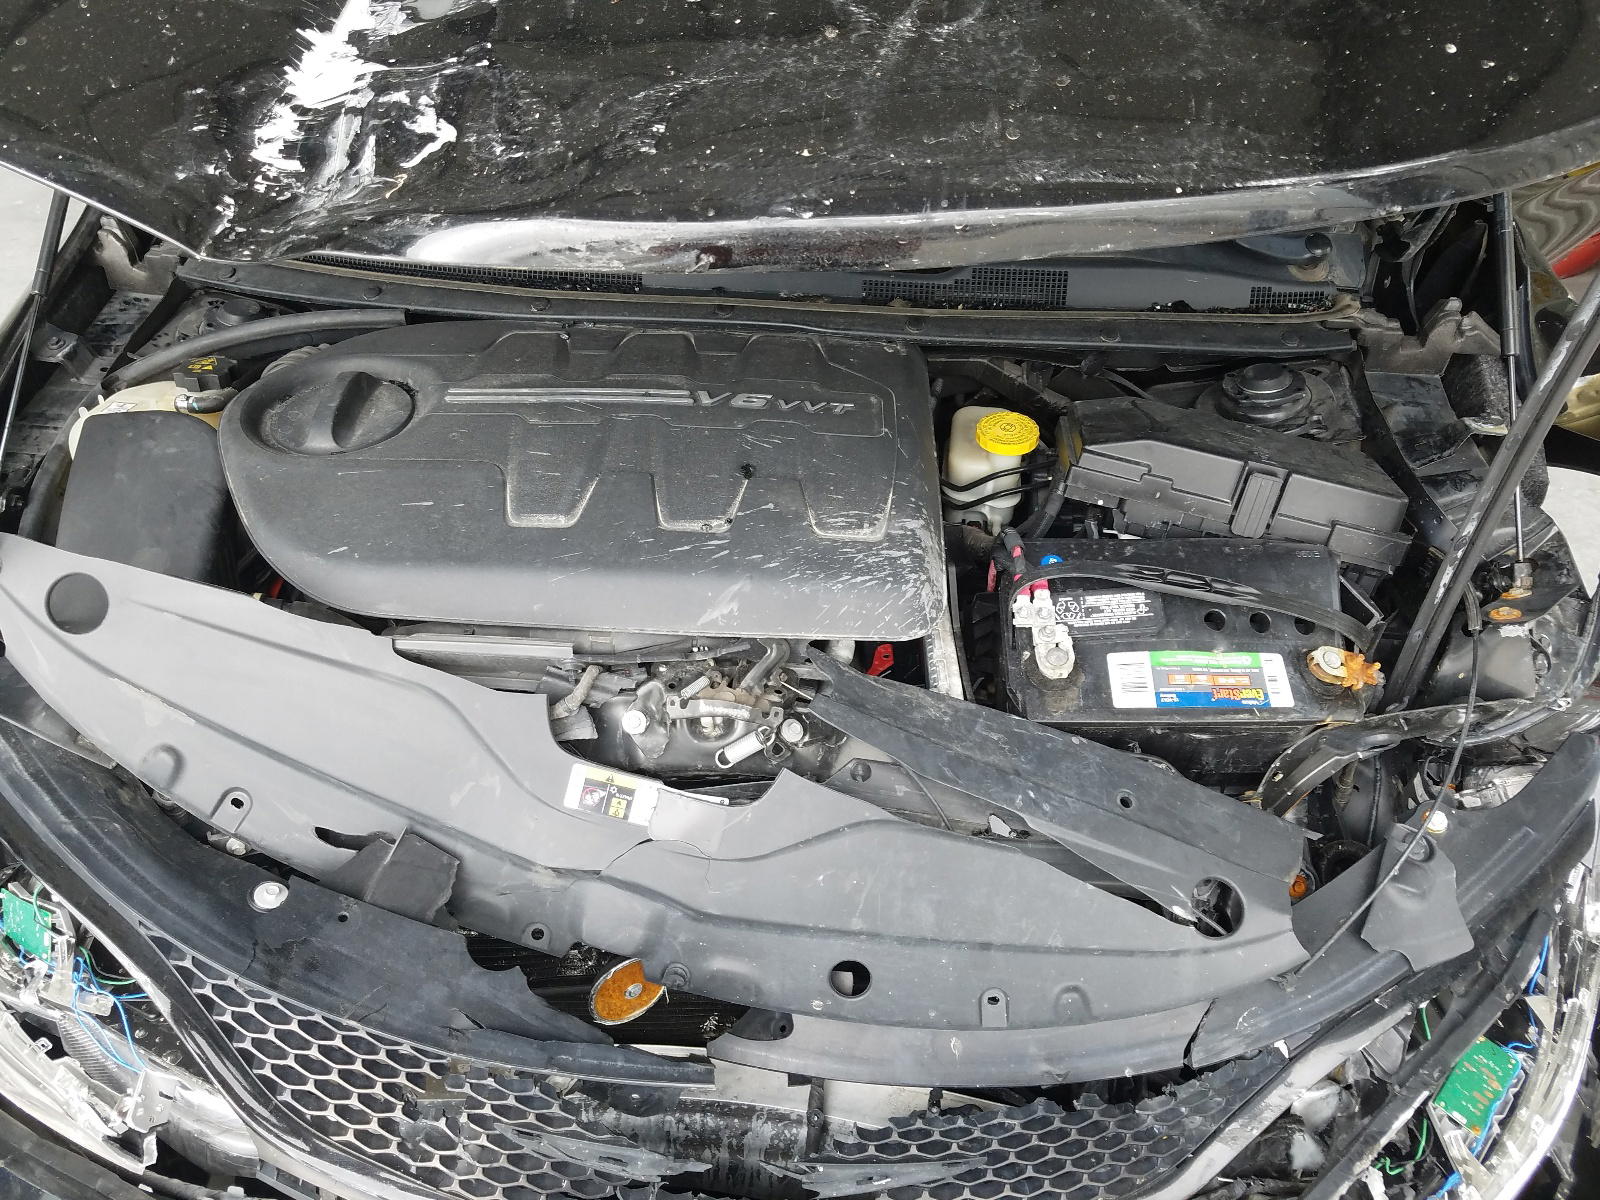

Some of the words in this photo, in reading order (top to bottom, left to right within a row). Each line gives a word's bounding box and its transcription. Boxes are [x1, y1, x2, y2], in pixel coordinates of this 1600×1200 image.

[697, 390, 774, 409] V6
[777, 399, 855, 415] VVT
[1211, 687, 1265, 702] EverStart
